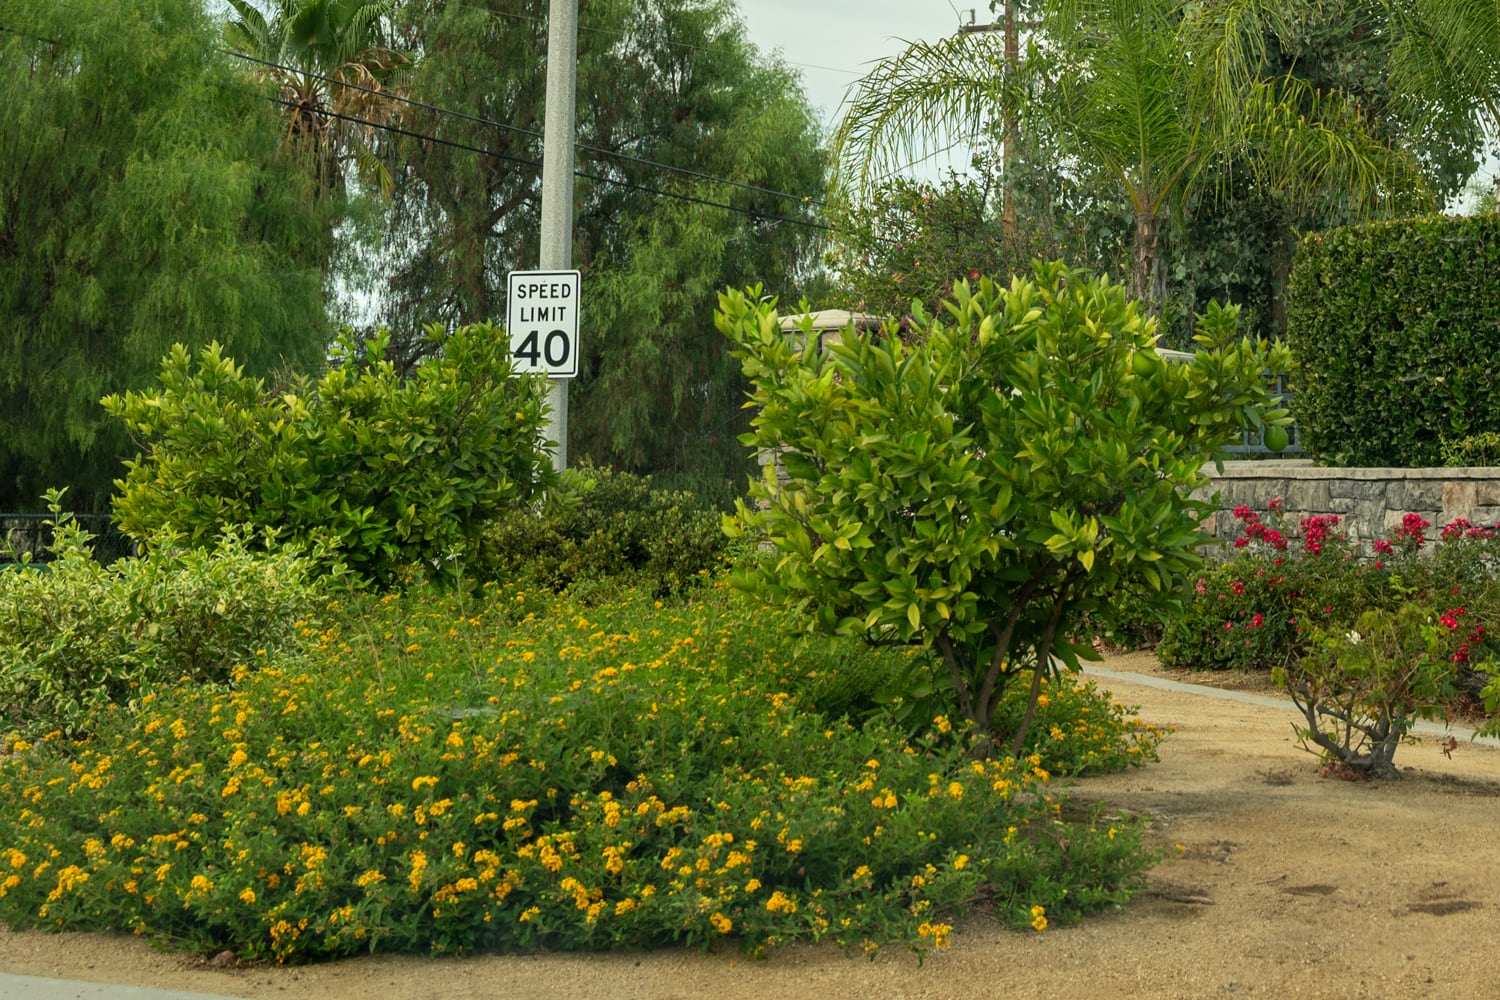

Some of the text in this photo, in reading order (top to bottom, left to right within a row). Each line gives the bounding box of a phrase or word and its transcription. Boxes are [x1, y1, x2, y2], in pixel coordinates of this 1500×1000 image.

[517, 283, 571, 299] SPEED
[520, 306, 567, 322] LIMIT
[513, 329, 570, 367] 40
